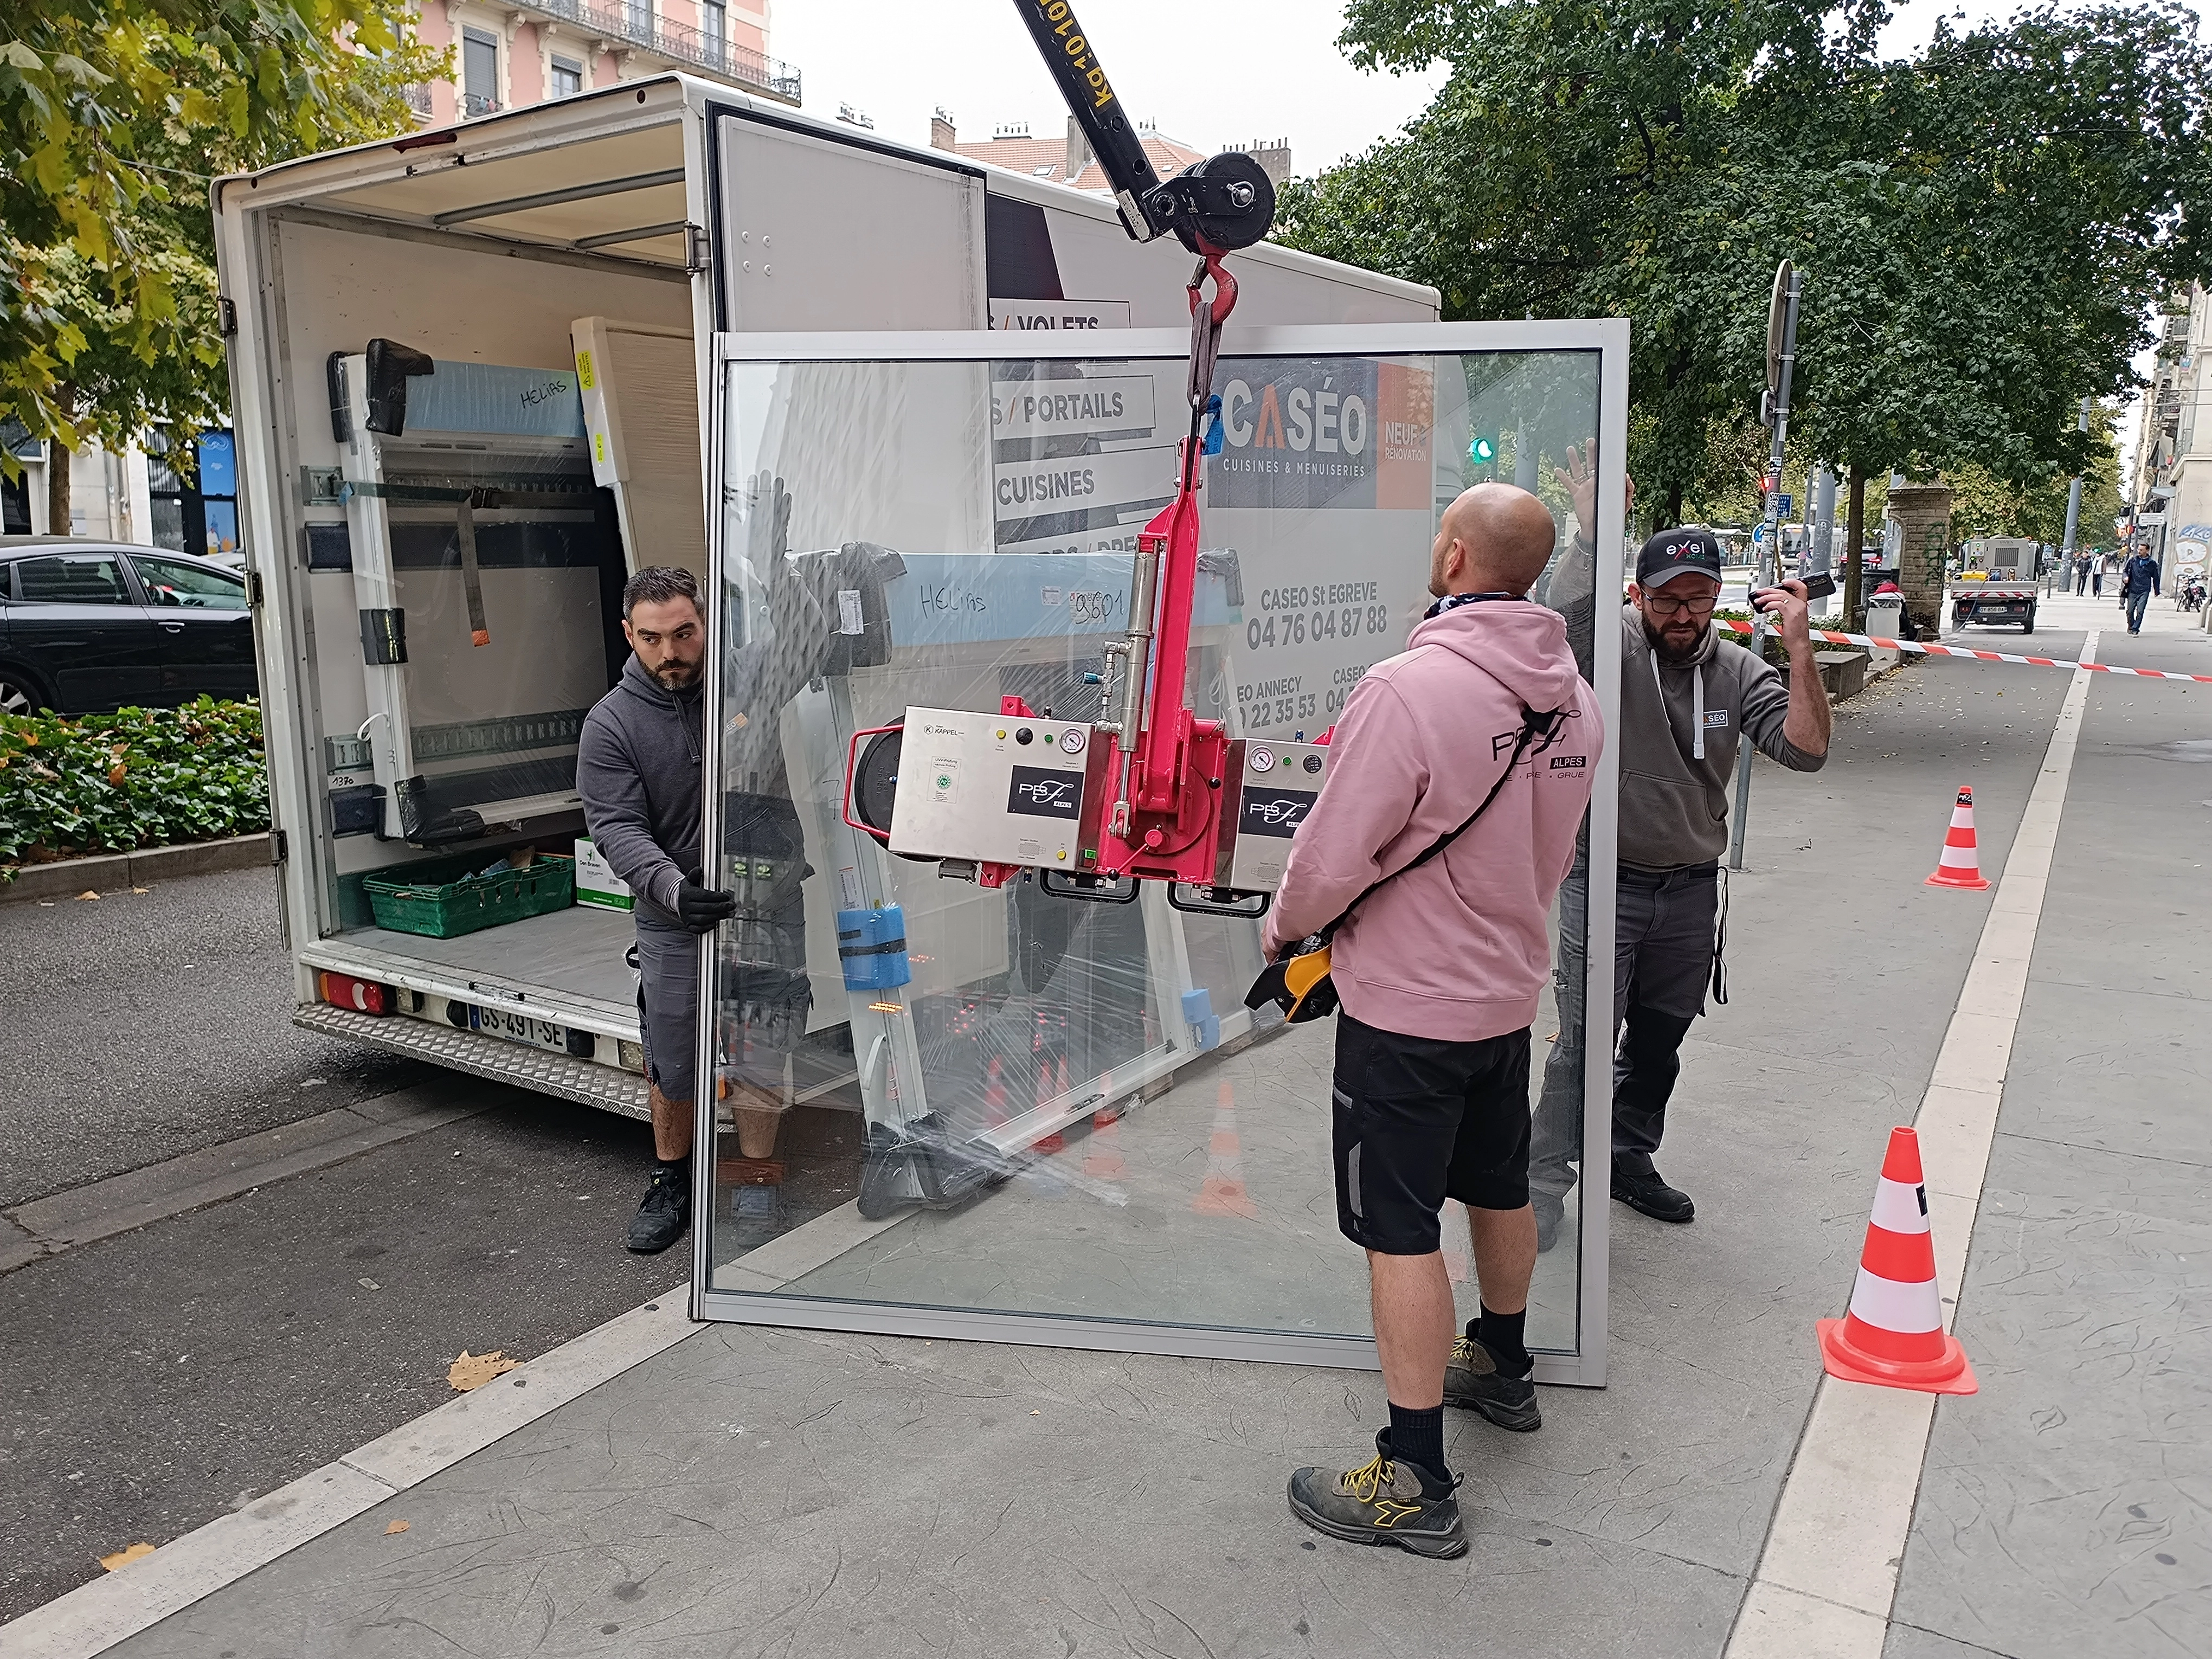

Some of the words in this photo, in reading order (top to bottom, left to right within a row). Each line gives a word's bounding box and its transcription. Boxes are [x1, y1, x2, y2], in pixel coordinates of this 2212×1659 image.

[1024, 391, 1123, 423] PORTAILS
[1221, 377, 1366, 455] CASÉO
[1385, 421, 1418, 446] NEUF
[1223, 458, 1278, 473] CUISINES
[1285, 465, 1290, 473] &
[1297, 462, 1365, 477] MENUISERIES
[997, 469, 1095, 505] CUISINES
[1261, 586, 1308, 610] CASEO
[1312, 586, 1325, 606] St
[1329, 581, 1377, 605] EGREVE
[1248, 616, 1275, 650] 04
[1282, 613, 1305, 646] 76
[1311, 610, 1336, 641] 04
[1341, 607, 1362, 637] 87
[1367, 605, 1387, 634] 88
[1256, 676, 1302, 699] ANNECY
[1333, 665, 1366, 685] CASEO
[1251, 702, 1270, 729] 22
[1275, 698, 1294, 724] 35
[1298, 693, 1315, 719] 53
[1703, 713, 1725, 723] ASÉO
[1553, 757, 1583, 768] ALPES
[480, 1006, 563, 1047] GS-491-SE
